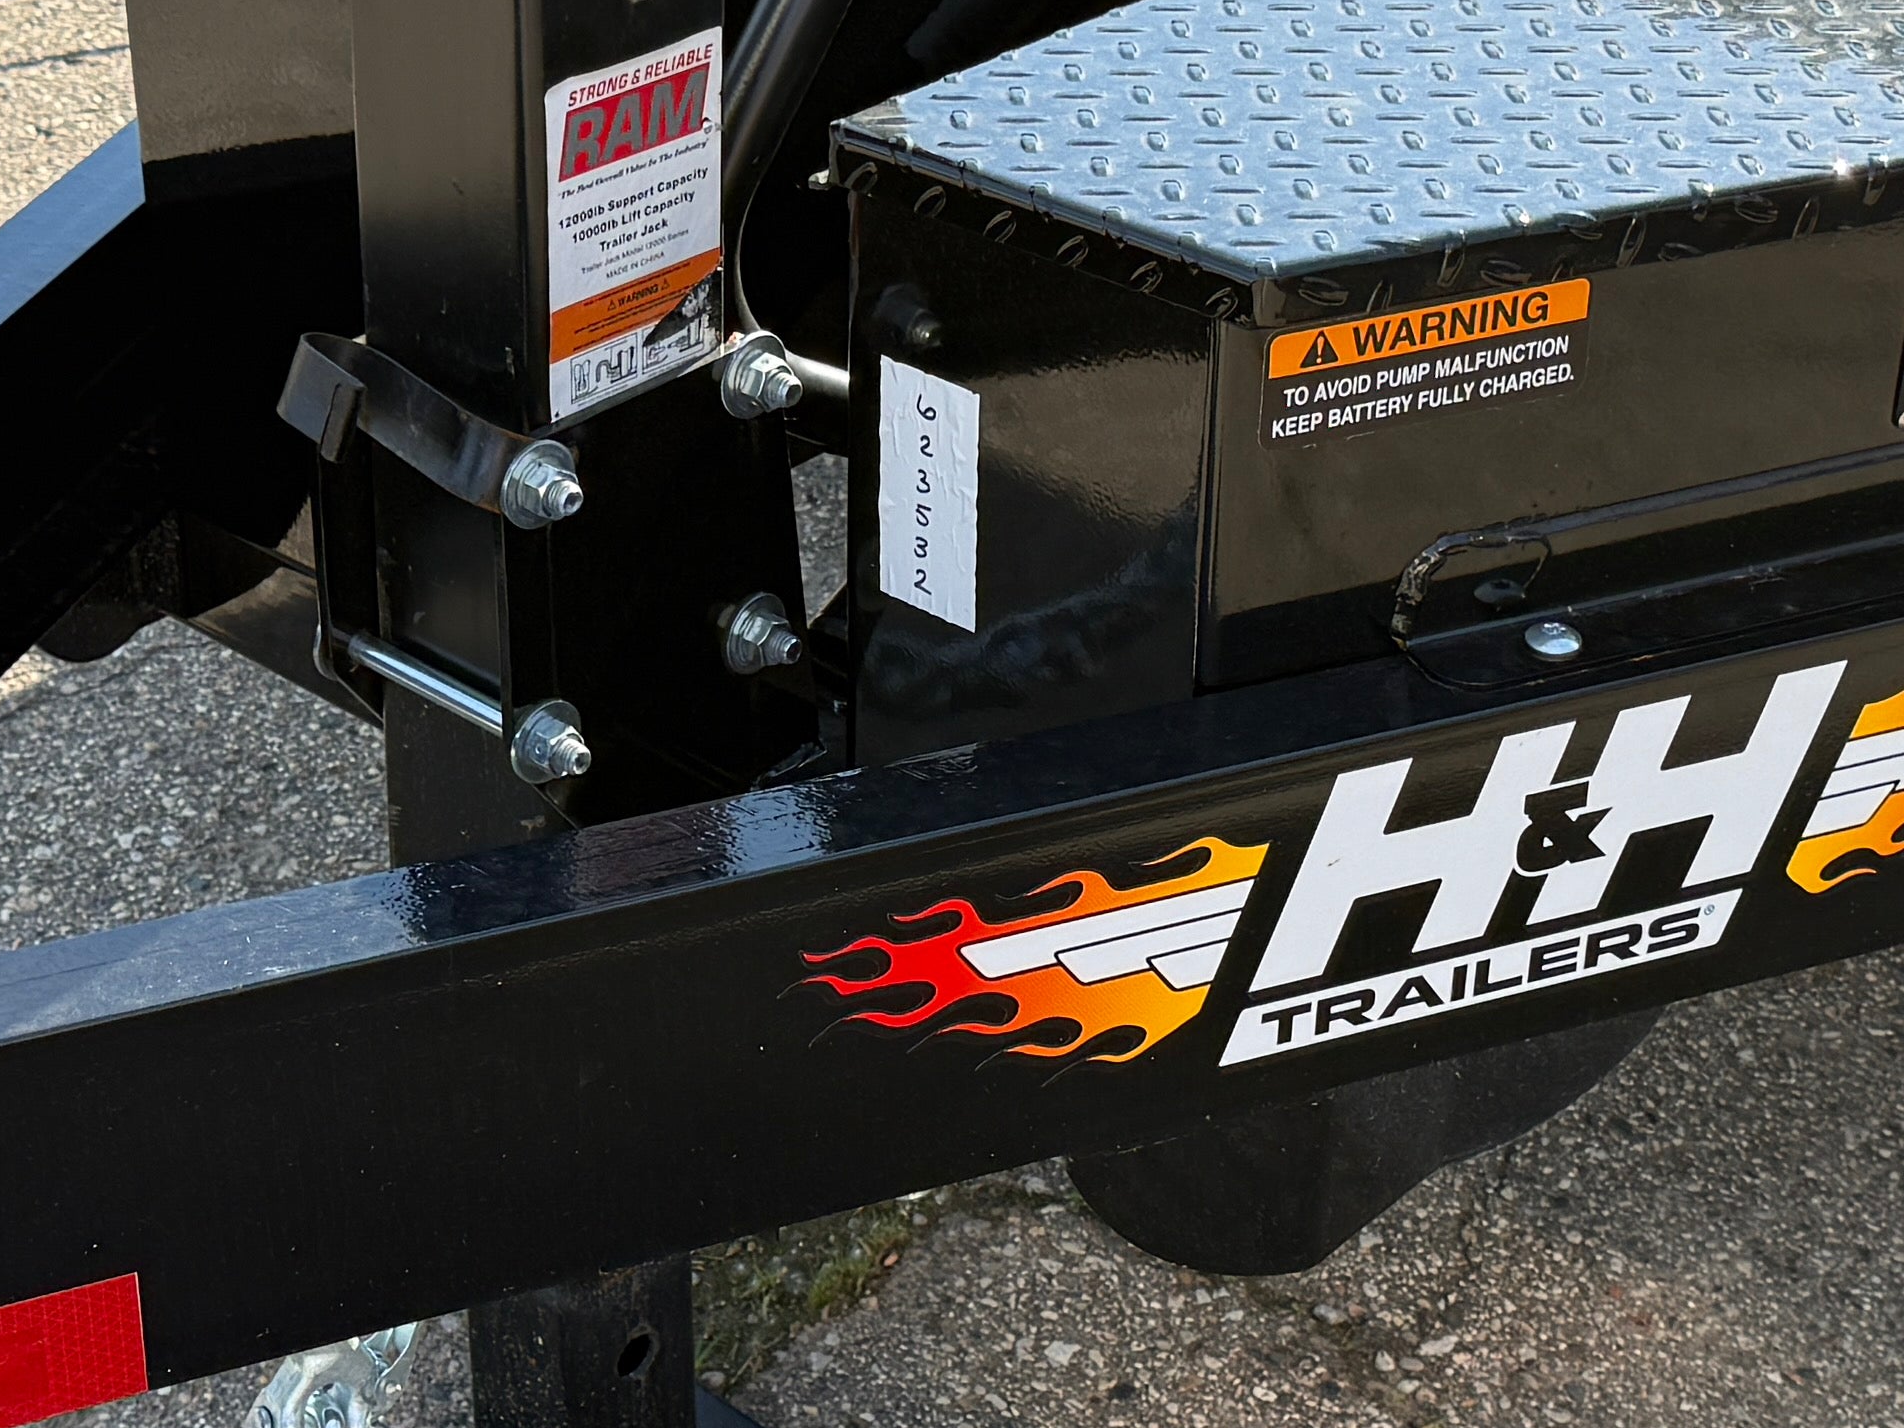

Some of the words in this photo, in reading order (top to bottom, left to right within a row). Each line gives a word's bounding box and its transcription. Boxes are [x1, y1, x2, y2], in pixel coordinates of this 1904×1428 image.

[568, 73, 629, 107] STRONG
[631, 68, 641, 85] &
[644, 43, 713, 81] RELIABLE
[563, 69, 707, 178] RAM
[558, 203, 604, 230] 12000lb
[607, 184, 653, 213] Support
[657, 164, 708, 196] Capacity
[572, 216, 618, 244] 10000lb
[621, 207, 640, 226] Lift
[644, 187, 695, 219] Capacity
[599, 228, 637, 253] Trailer
[640, 216, 668, 237] Jack
[1352, 291, 1550, 357] WARNING
[1271, 412, 1322, 439] KEEP
[1328, 394, 1413, 429] BATTERY
[1417, 381, 1476, 410] FULLY
[1479, 363, 1575, 398] CHARGED.
[1283, 386, 1309, 408] TO
[1313, 375, 1371, 402] AVOID
[1376, 361, 1430, 390] PUMP
[1434, 335, 1569, 378] MALFUNCTION
[913, 394, 937, 596] 623532
[1248, 659, 1848, 994] H&H
[1261, 907, 1700, 1046] TRAILERS
